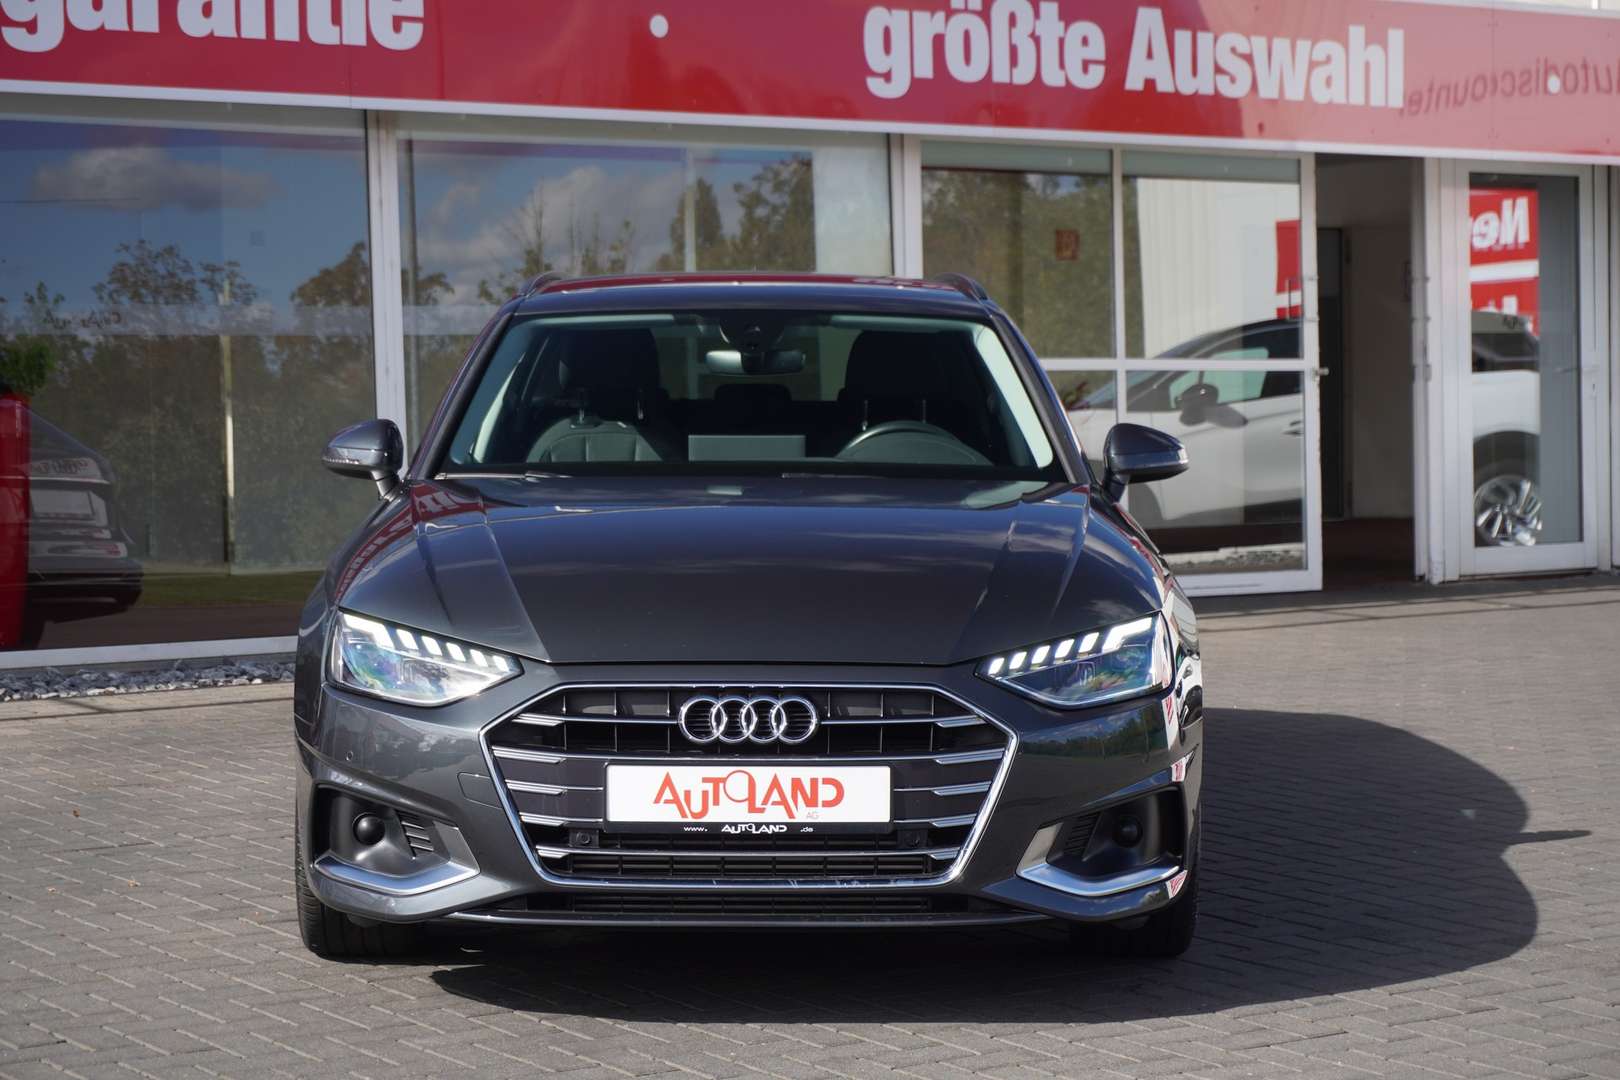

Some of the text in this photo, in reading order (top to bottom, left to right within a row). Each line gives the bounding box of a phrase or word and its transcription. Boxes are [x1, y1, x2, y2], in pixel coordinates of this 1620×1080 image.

[863, 0, 1405, 108] größte Auswahl
[806, 810, 820, 820] AG
[721, 822, 787, 834] AUTOLAND
[800, 825, 814, 833] .de
